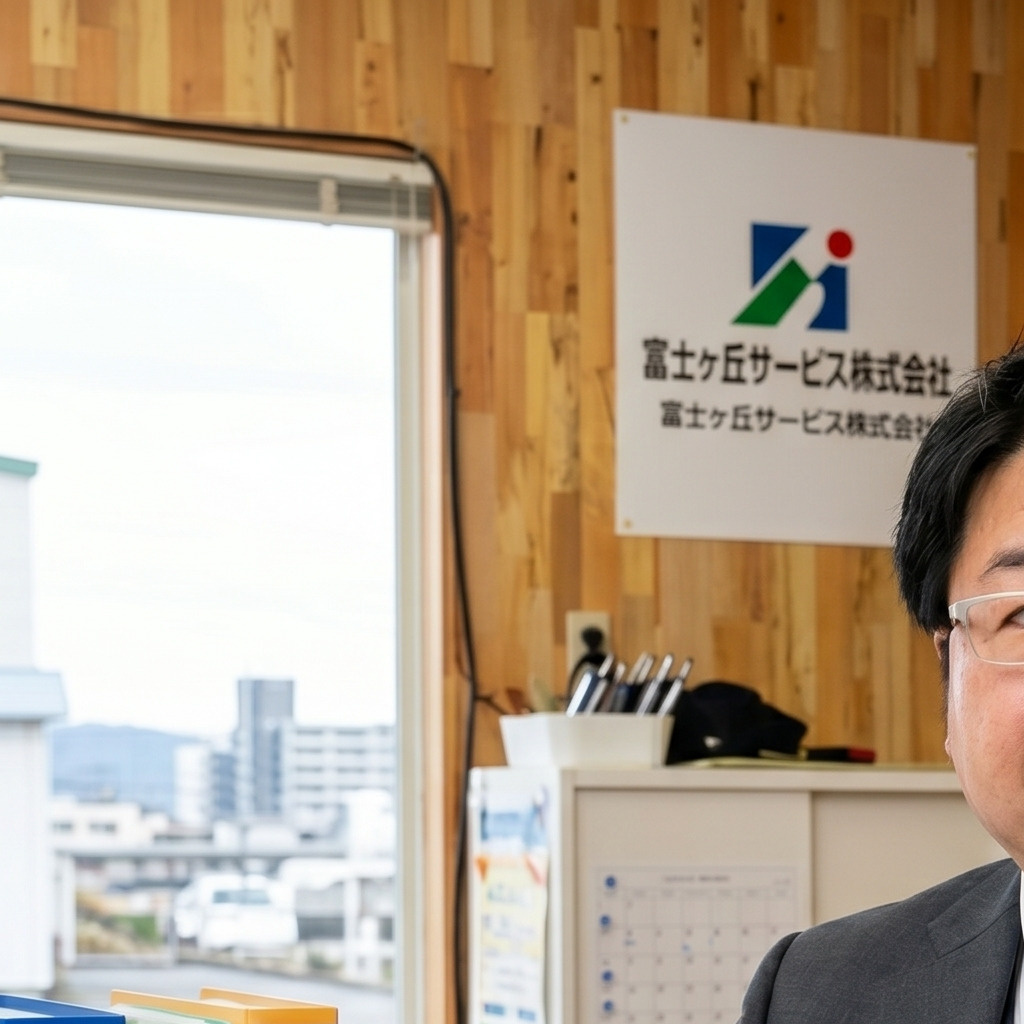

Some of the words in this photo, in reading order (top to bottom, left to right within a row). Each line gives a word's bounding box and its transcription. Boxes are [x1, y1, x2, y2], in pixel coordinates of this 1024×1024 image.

[643, 338, 952, 398] 富士ヶ丘サービス株式会社
